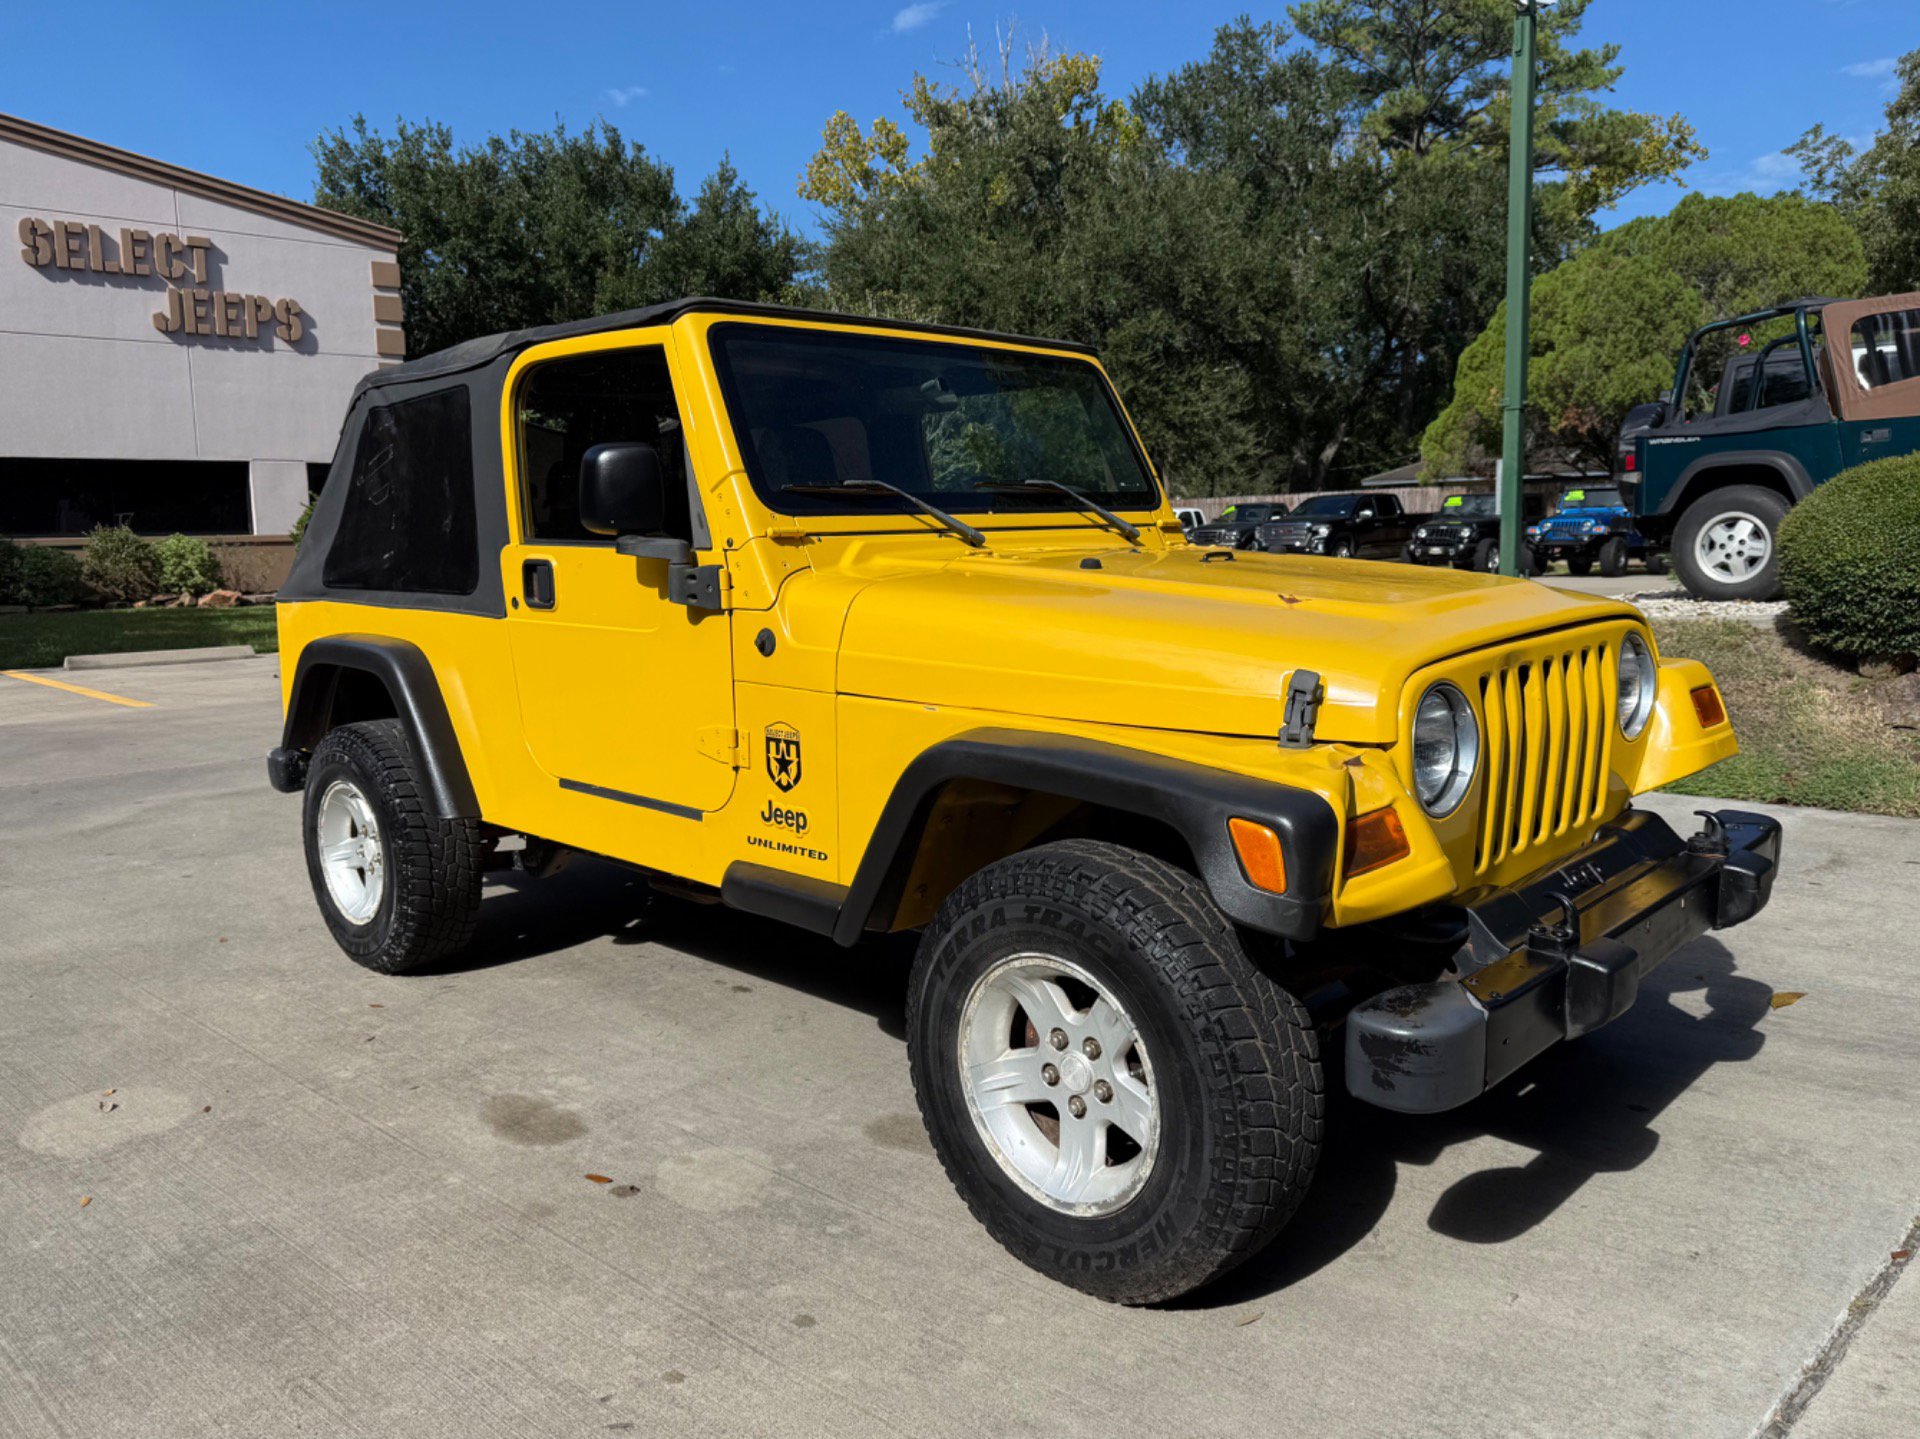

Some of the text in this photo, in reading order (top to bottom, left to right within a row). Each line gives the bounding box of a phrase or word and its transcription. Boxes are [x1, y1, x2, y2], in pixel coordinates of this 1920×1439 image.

[18, 217, 212, 285] SELECT
[152, 287, 303, 342] JEEPS
[760, 799, 808, 834] Jeep
[747, 835, 828, 861] UNLIMITED
[933, 904, 1113, 983] TERRA TRAC
